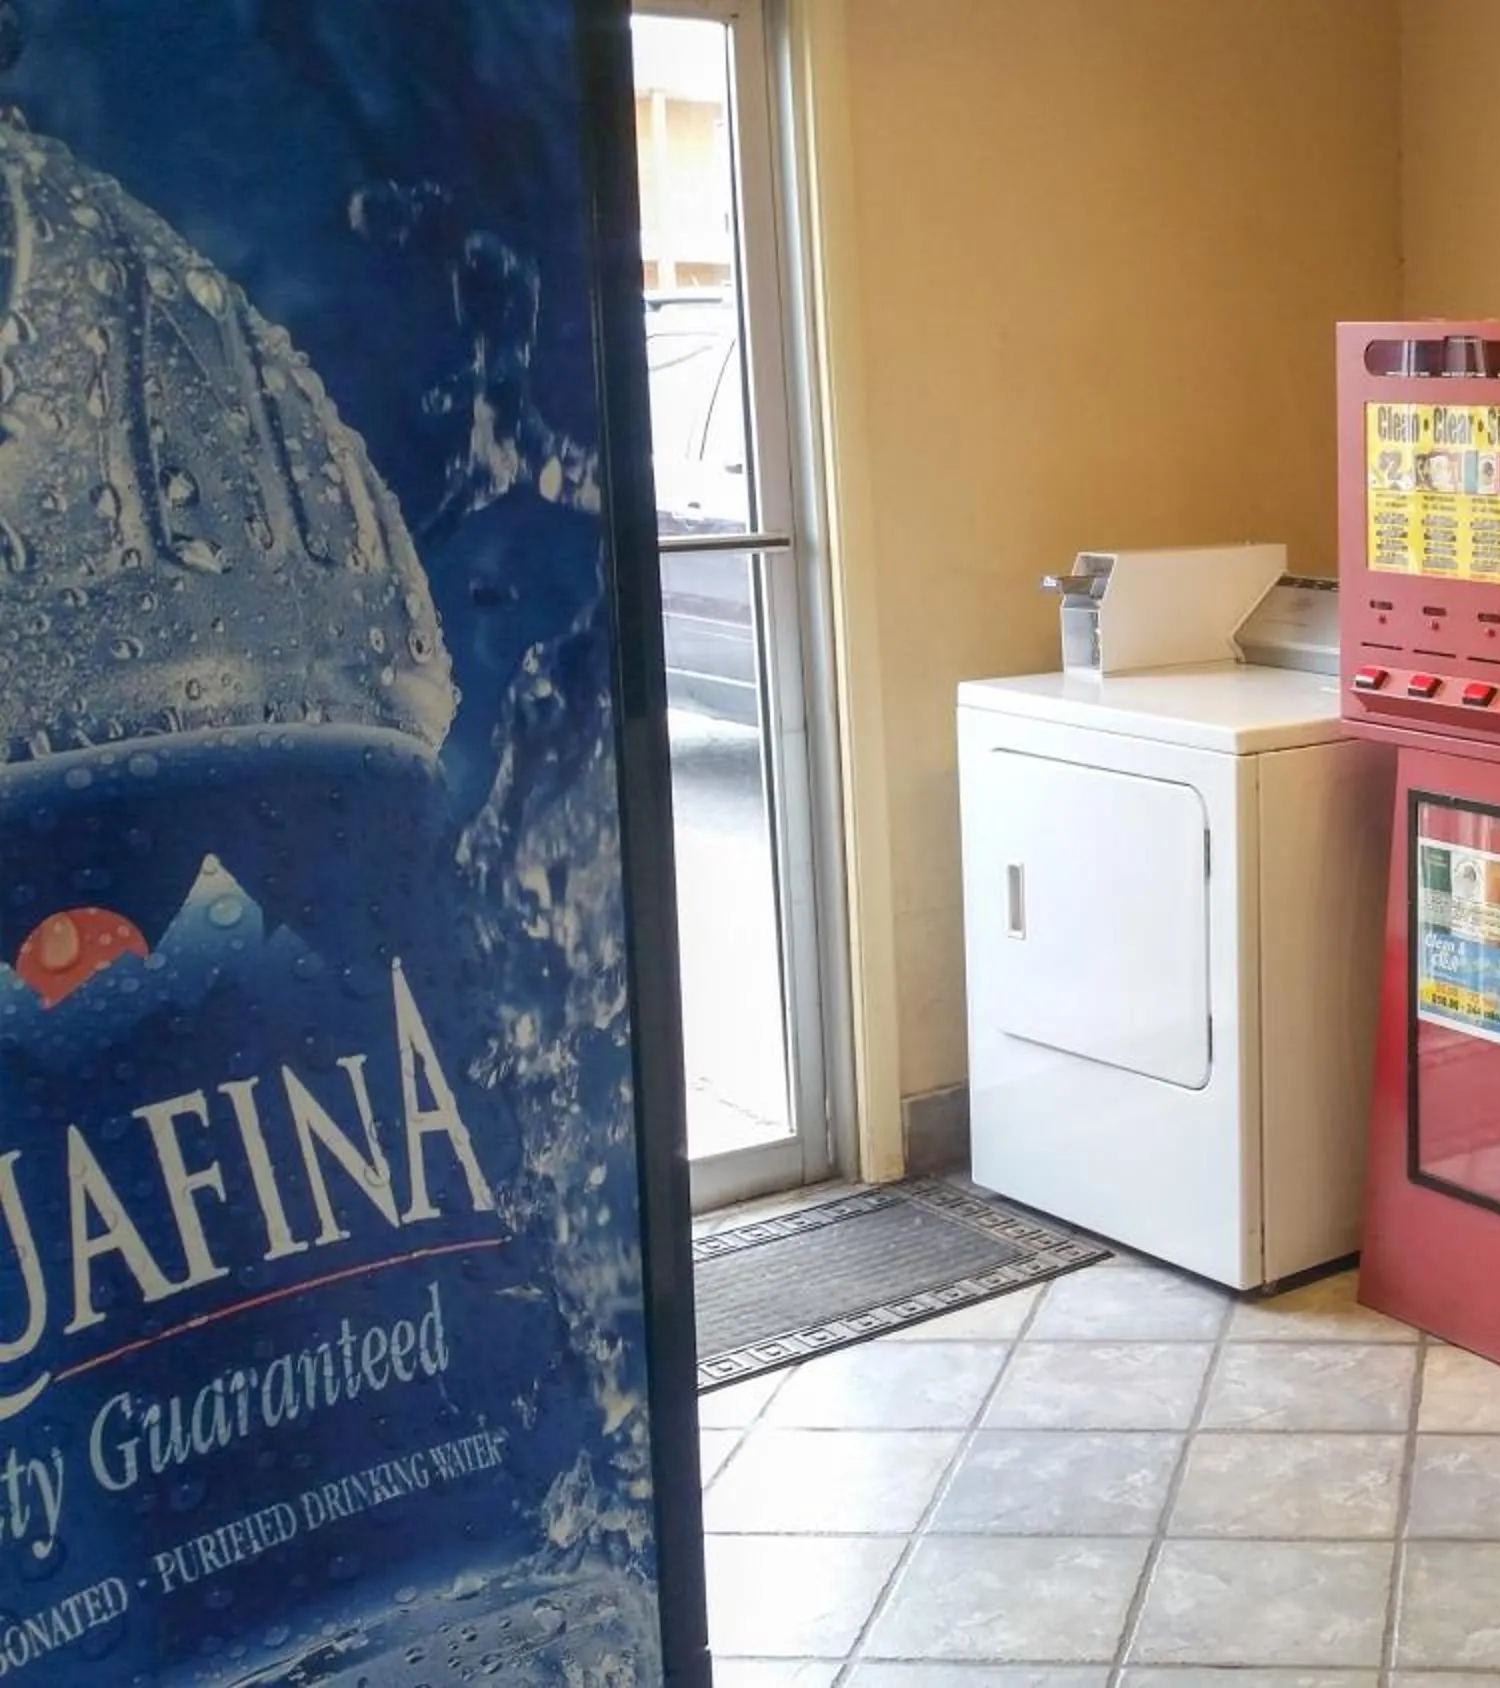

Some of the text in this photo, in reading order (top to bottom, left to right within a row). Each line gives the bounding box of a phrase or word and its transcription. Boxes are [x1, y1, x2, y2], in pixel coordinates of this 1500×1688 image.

[1377, 405, 1422, 444] Clean
[1433, 406, 1475, 445] Clear
[89, 1280, 450, 1492] Guaranteed
[154, 1502, 297, 1593] PURIFIED
[301, 1452, 430, 1532] DRINKING
[430, 1430, 506, 1482] WATER
